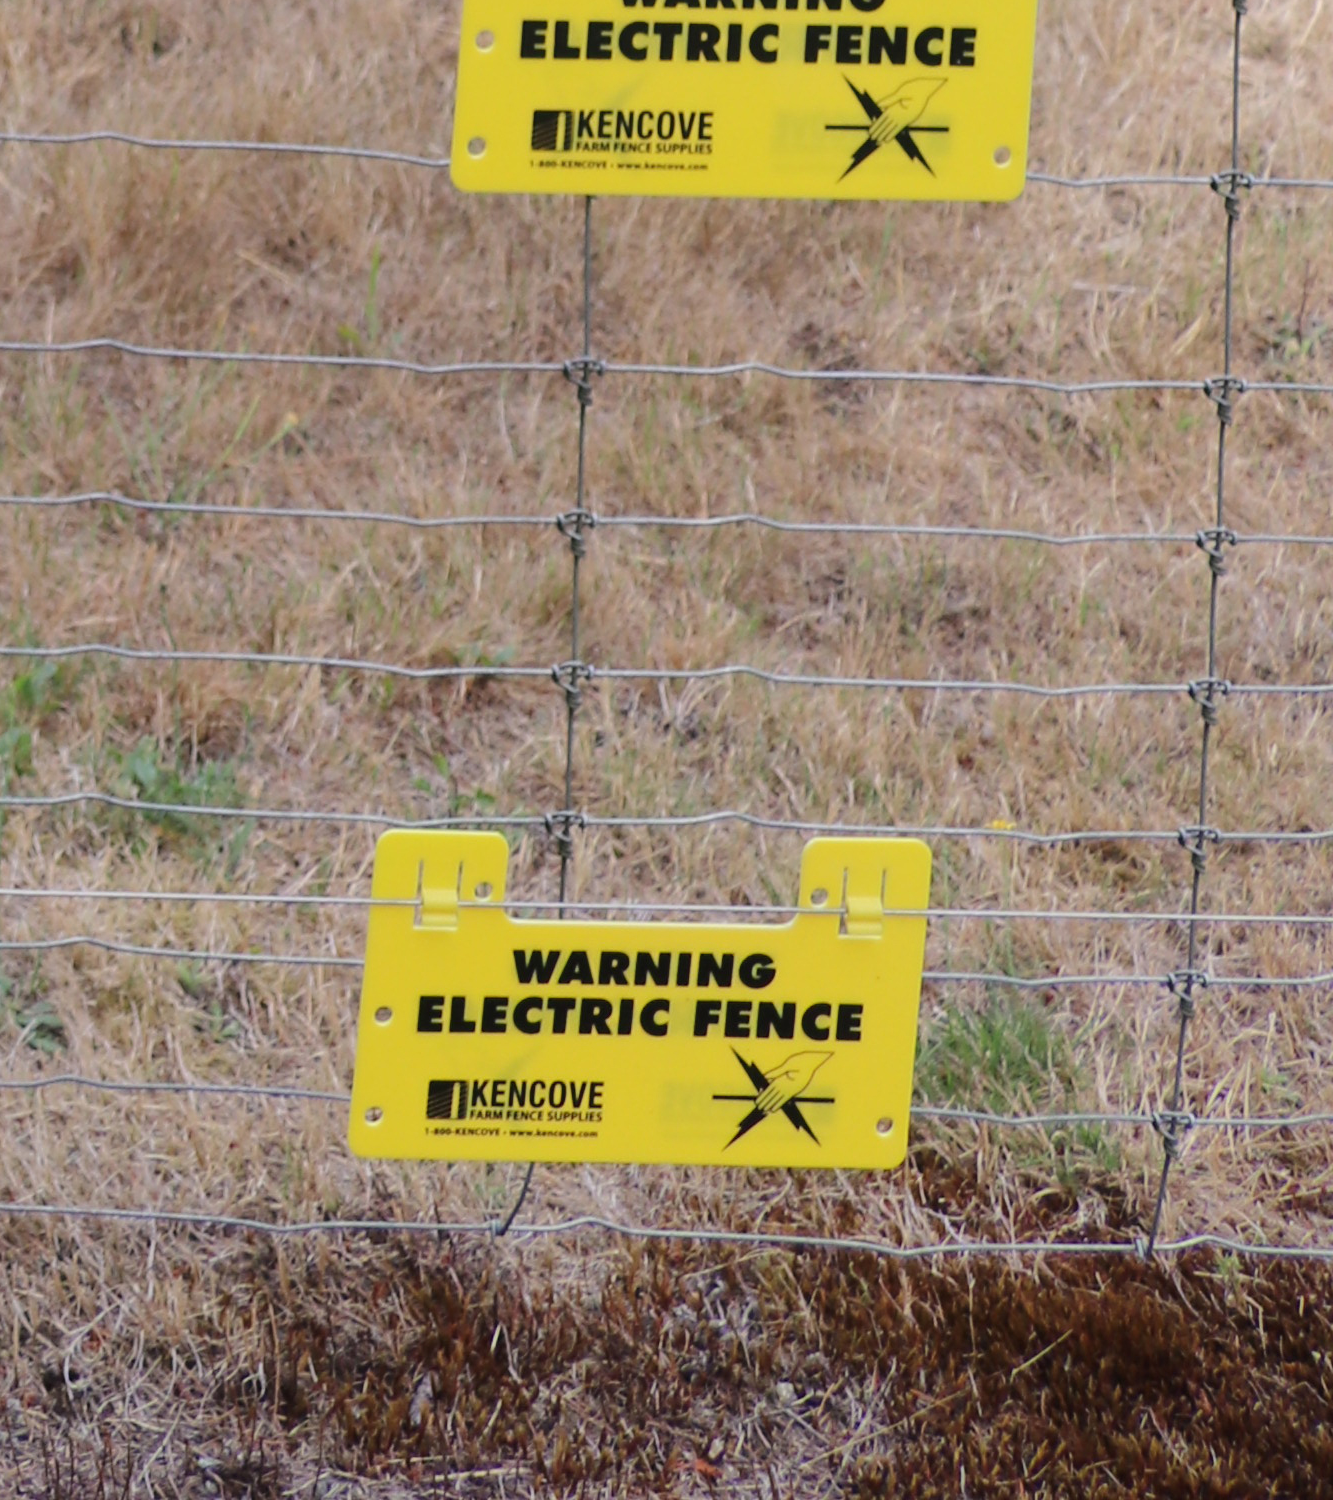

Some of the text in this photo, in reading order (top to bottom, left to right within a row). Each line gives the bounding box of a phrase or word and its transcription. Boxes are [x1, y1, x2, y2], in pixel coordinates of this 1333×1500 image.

[520, 19, 977, 67] ELECTRIC FENCE
[577, 110, 714, 140] KENCOVE
[576, 142, 713, 155] FARM FENCE SUPPLIES
[513, 949, 776, 989] WARNING
[417, 995, 864, 1041] ELECTRIC FENCE
[471, 1080, 604, 1109] KENCOVE
[470, 1110, 603, 1122] FARM FENCE SUPPLIES
[425, 1127, 500, 1137] 1-800-KENCOVE
